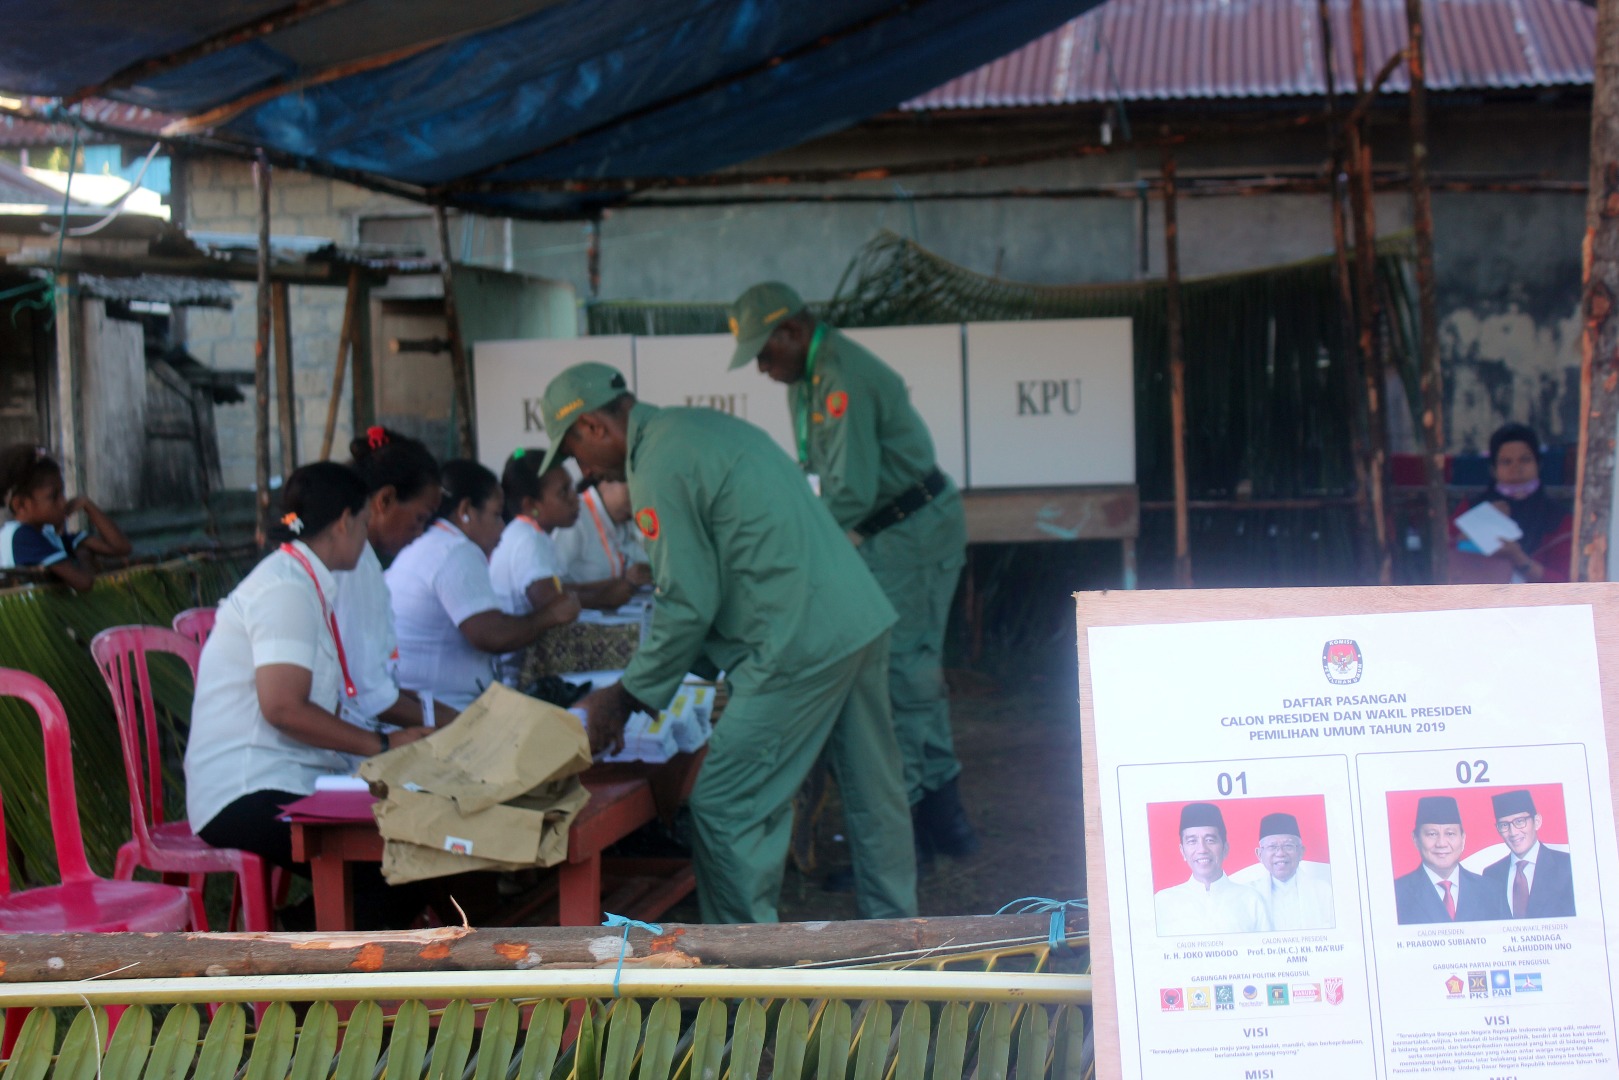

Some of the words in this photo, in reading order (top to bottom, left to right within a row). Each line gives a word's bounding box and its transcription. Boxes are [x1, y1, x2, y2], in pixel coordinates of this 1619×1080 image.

[1017, 379, 1081, 416] KPU
[1283, 697, 1332, 708] DAFTAR
[1336, 694, 1407, 706] PASANGAN
[1221, 716, 1264, 727] CALON
[1268, 712, 1329, 724] PRESIDEN
[1334, 711, 1362, 721] DAN
[1366, 709, 1407, 720] WAKIL
[1411, 705, 1472, 718] PRESIDEN
[1249, 728, 1319, 741] PEMILIHAN
[1324, 726, 1365, 737] UMUM
[1371, 724, 1412, 735] TAHUN
[1416, 722, 1446, 733] 2019
[1456, 760, 1490, 784] 02
[1217, 772, 1247, 796] 01
[1406, 940, 1446, 948] PRABOWO
[1448, 937, 1486, 946] SUBIANTO
[1520, 934, 1561, 942] SANDIAGA
[1502, 944, 1553, 952] SALAHUDDIN
[1485, 1016, 1510, 1026] VISI
[1244, 1028, 1269, 1038] VISI
[1245, 1070, 1274, 1080] MISI
